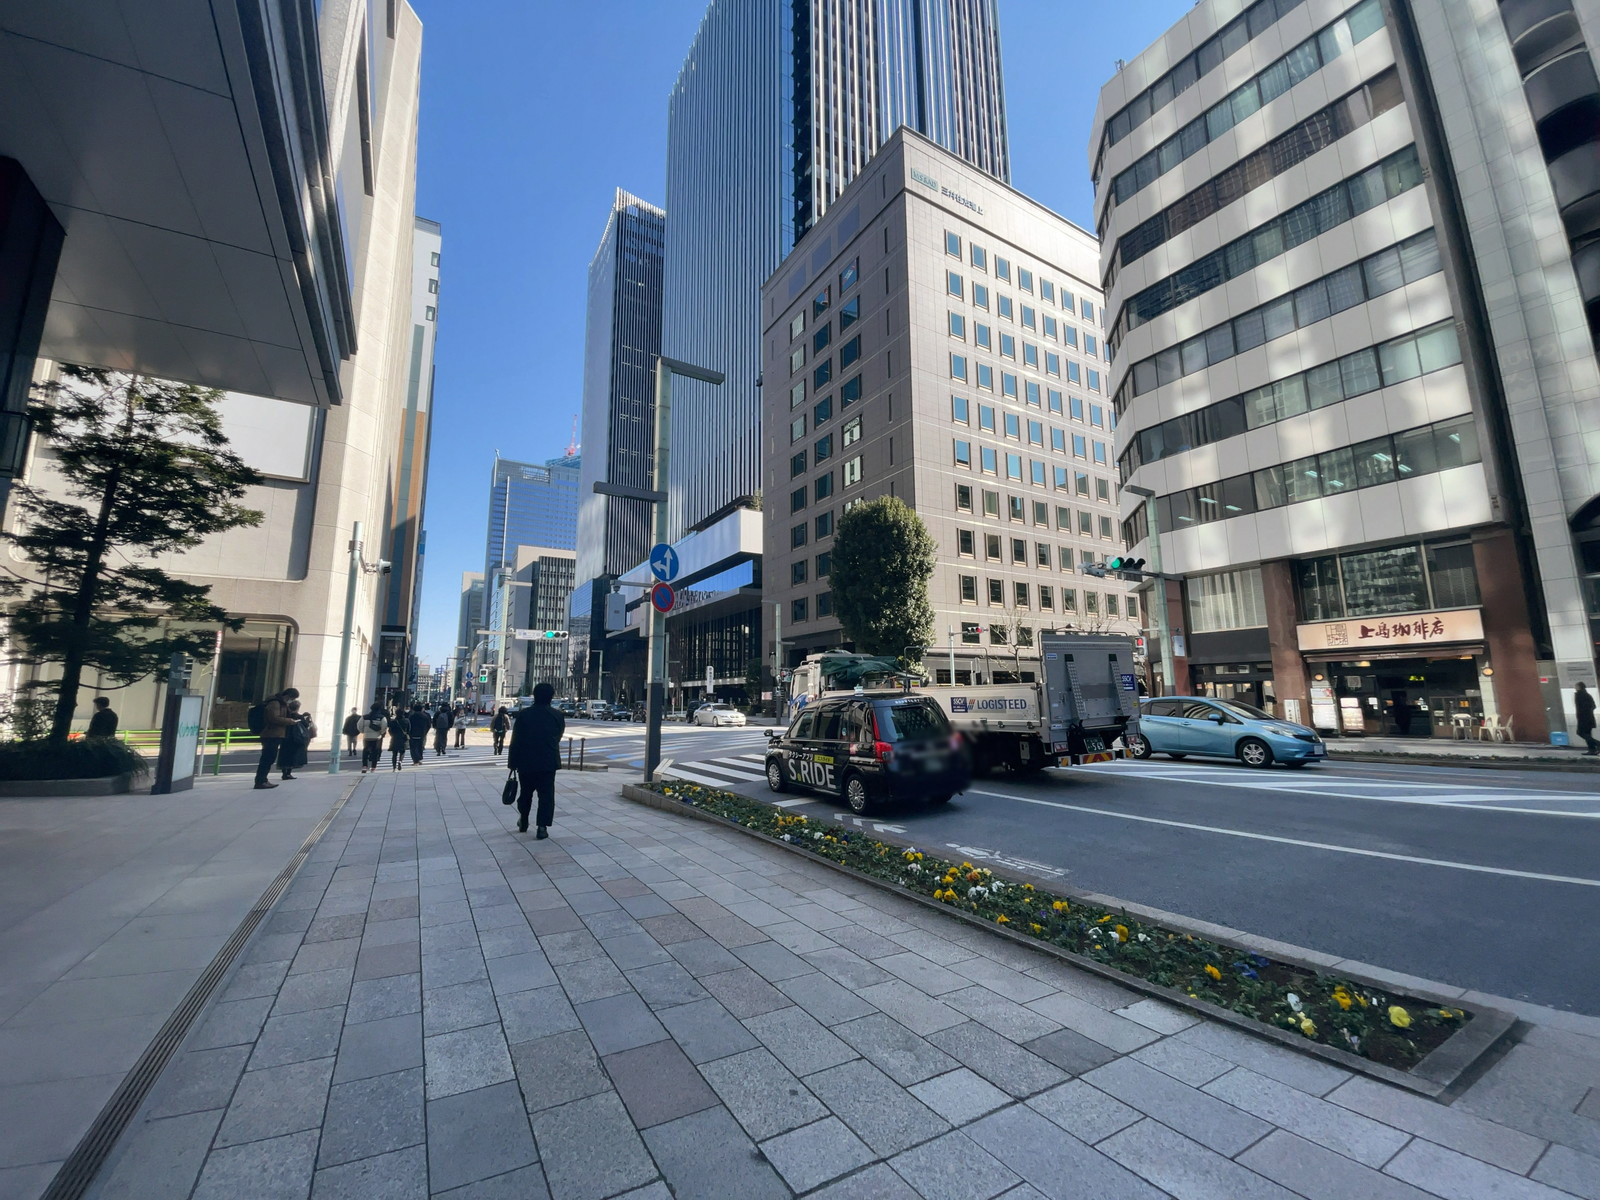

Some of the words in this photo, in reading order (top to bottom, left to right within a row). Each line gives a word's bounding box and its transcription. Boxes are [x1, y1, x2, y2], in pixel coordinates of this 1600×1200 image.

[1358, 616, 1445, 641] 上島珈琲店
[977, 699, 1027, 710] LOGISTEED
[788, 758, 837, 790] S.RIDE
